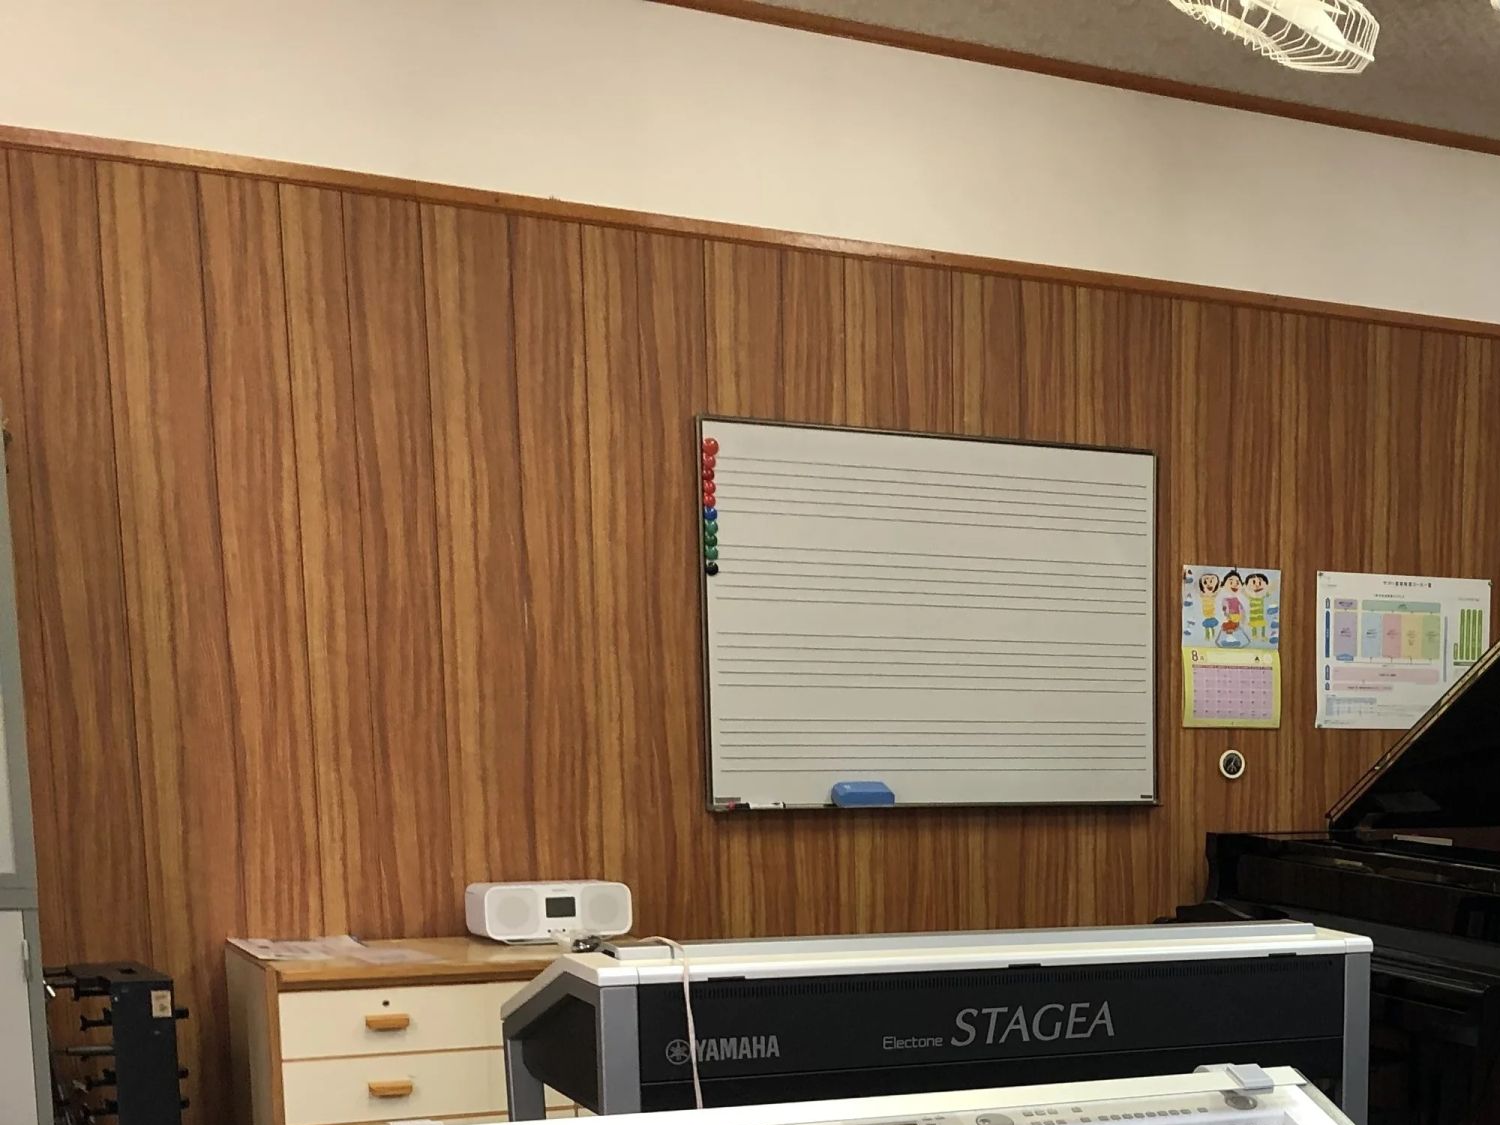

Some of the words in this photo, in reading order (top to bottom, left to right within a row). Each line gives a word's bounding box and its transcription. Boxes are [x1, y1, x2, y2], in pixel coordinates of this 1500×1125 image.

[882, 1035, 944, 1050] Electone
[950, 1000, 1115, 1047] STAGEA
[695, 1035, 780, 1062] YAMAHA
